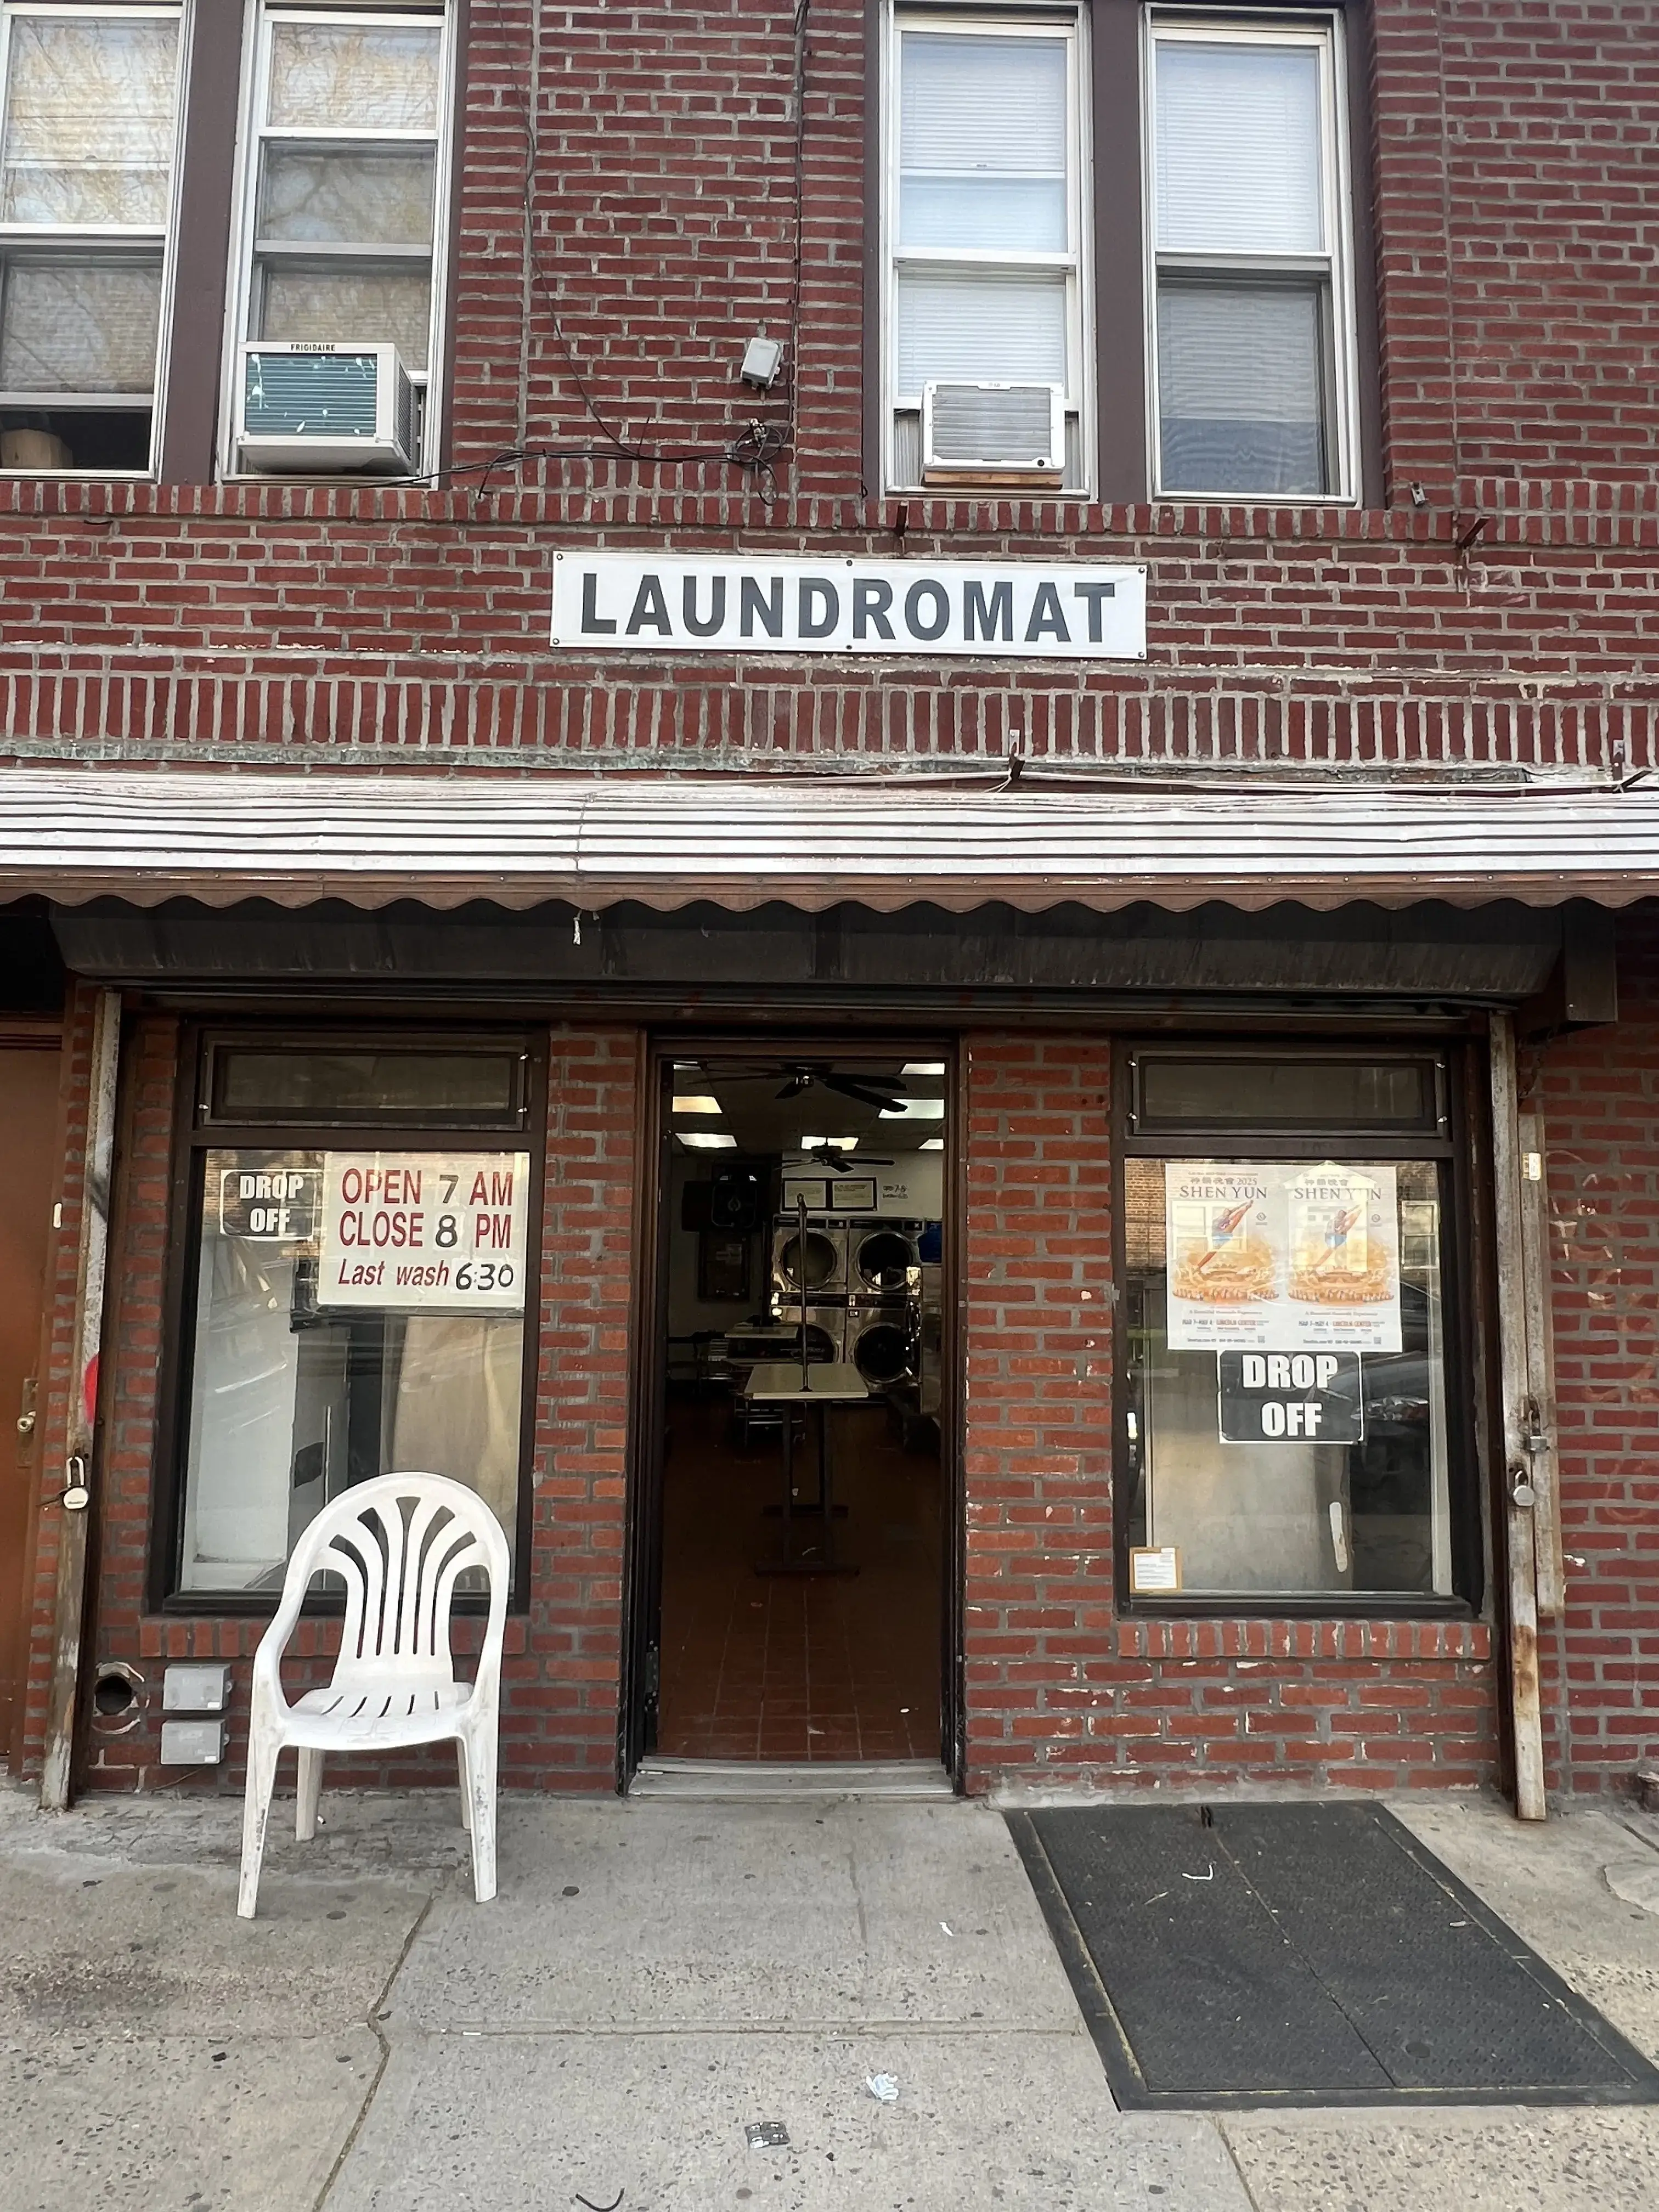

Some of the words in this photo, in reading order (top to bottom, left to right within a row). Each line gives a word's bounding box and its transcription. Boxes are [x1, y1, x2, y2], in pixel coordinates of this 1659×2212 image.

[291, 343, 336, 352] FRIGIDAIRE
[581, 573, 1115, 643] LAUNDROMAT
[239, 1175, 304, 1199] DROP
[342, 1168, 421, 1204] OPEN
[439, 1174, 459, 1204] 7
[469, 1171, 513, 1206] AM
[1179, 1185, 1227, 1199] SHEN
[1232, 1186, 1267, 1199] YUN
[1294, 1187, 1340, 1200] SHEN
[250, 1208, 291, 1232] OFF
[340, 1210, 424, 1248] CLOSE
[436, 1215, 459, 1248] 8
[475, 1213, 511, 1249] PM
[338, 1258, 385, 1286] Last
[396, 1260, 449, 1286] wash
[456, 1262, 514, 1290] 6:30
[1242, 1354, 1338, 1389] DROP
[1261, 1401, 1322, 1437] OFF
